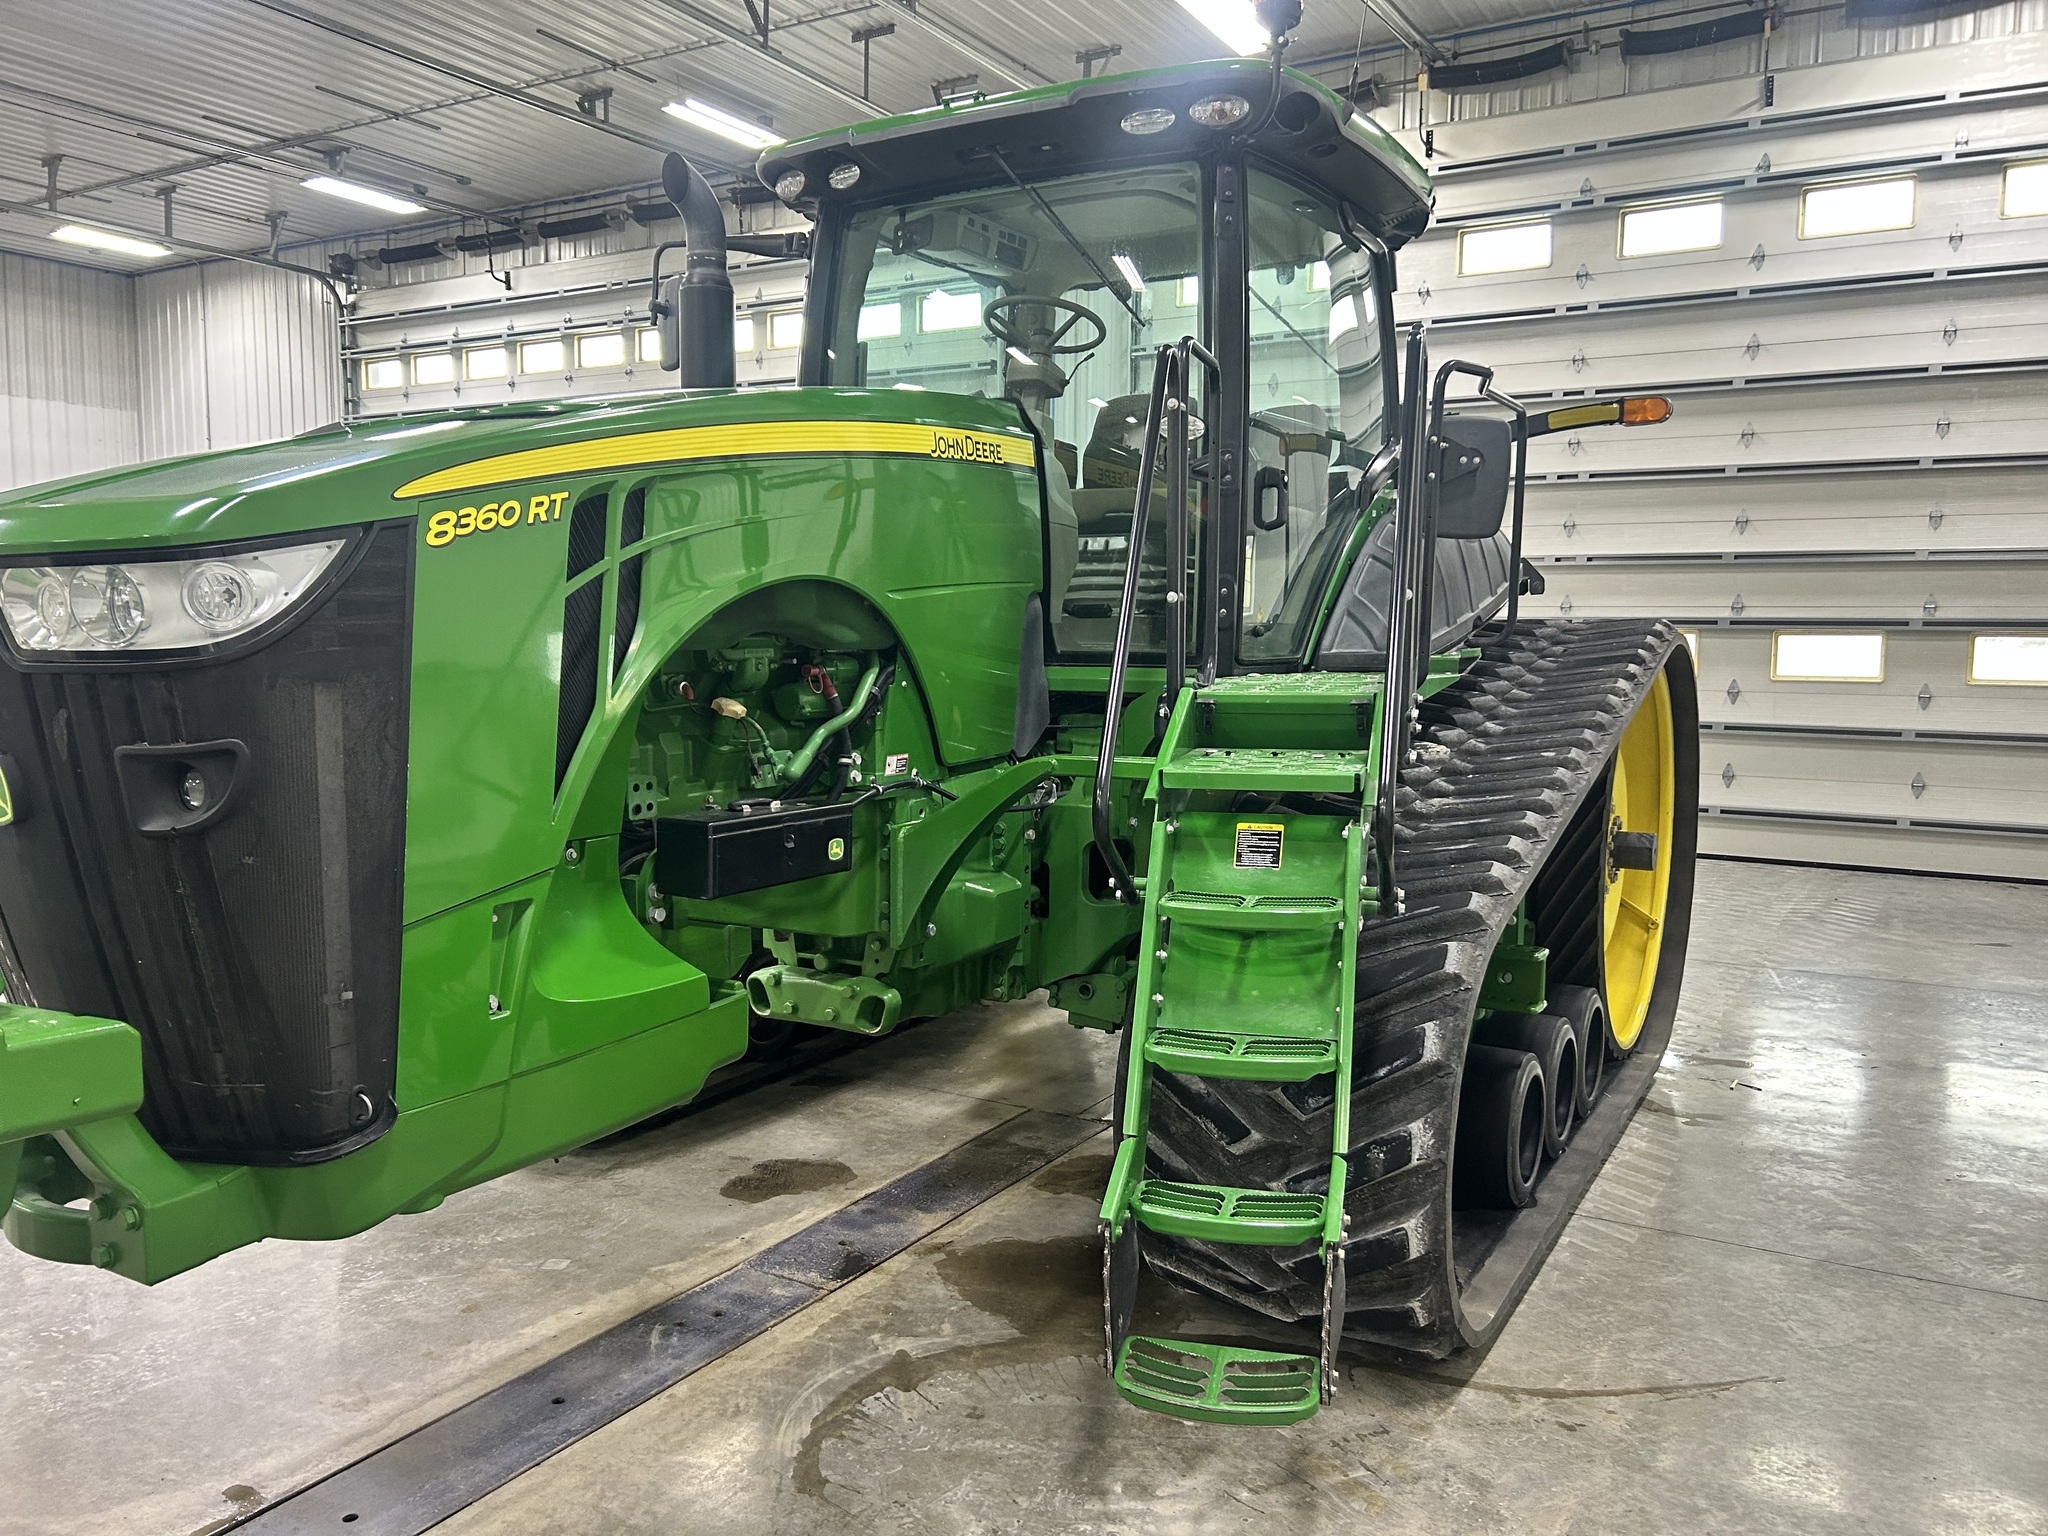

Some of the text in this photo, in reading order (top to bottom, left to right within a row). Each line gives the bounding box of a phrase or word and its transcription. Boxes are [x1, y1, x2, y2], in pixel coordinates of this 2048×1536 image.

[931, 431, 1003, 461] JOHN DEERE
[425, 491, 571, 548] 8360 RT
